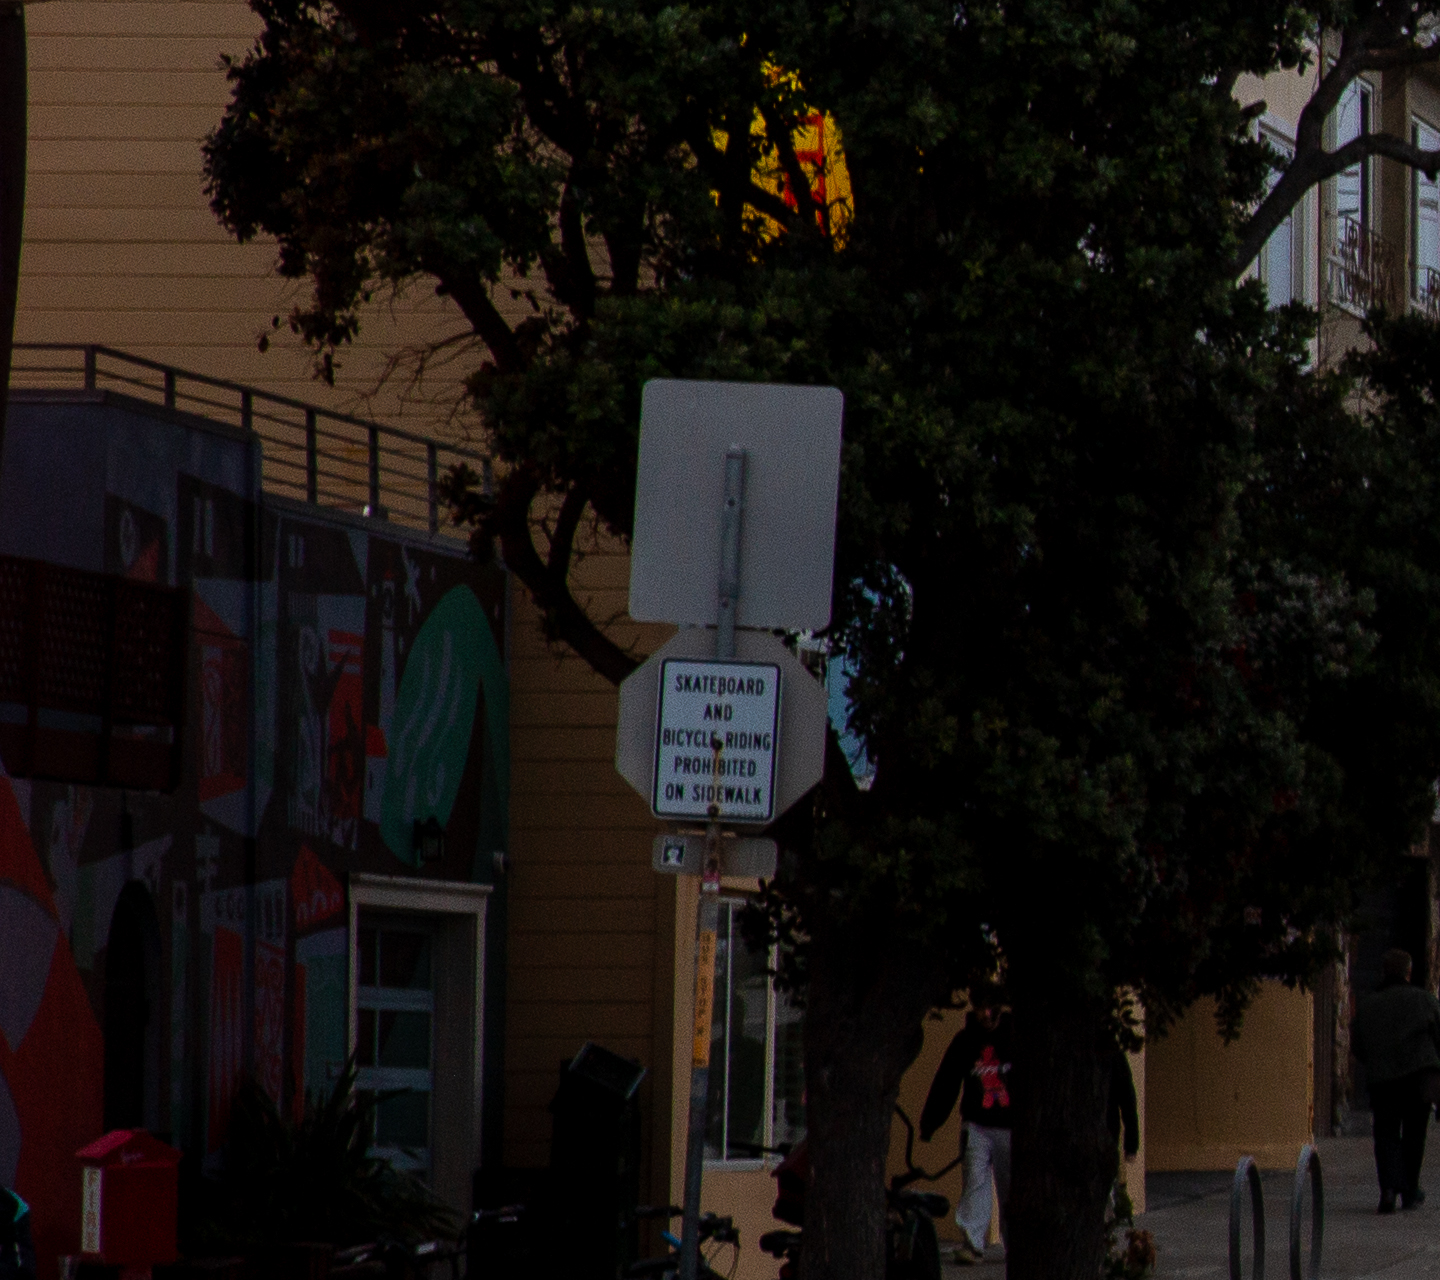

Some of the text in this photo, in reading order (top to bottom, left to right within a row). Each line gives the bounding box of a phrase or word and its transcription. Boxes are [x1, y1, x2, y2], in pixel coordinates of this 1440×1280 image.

[675, 674, 765, 696] SKATEBOARD
[704, 703, 733, 721] AND
[663, 728, 771, 751] BICYCLE RIDING
[674, 756, 757, 778] PROHIBITED
[665, 783, 762, 805] ON SIDEWALK
